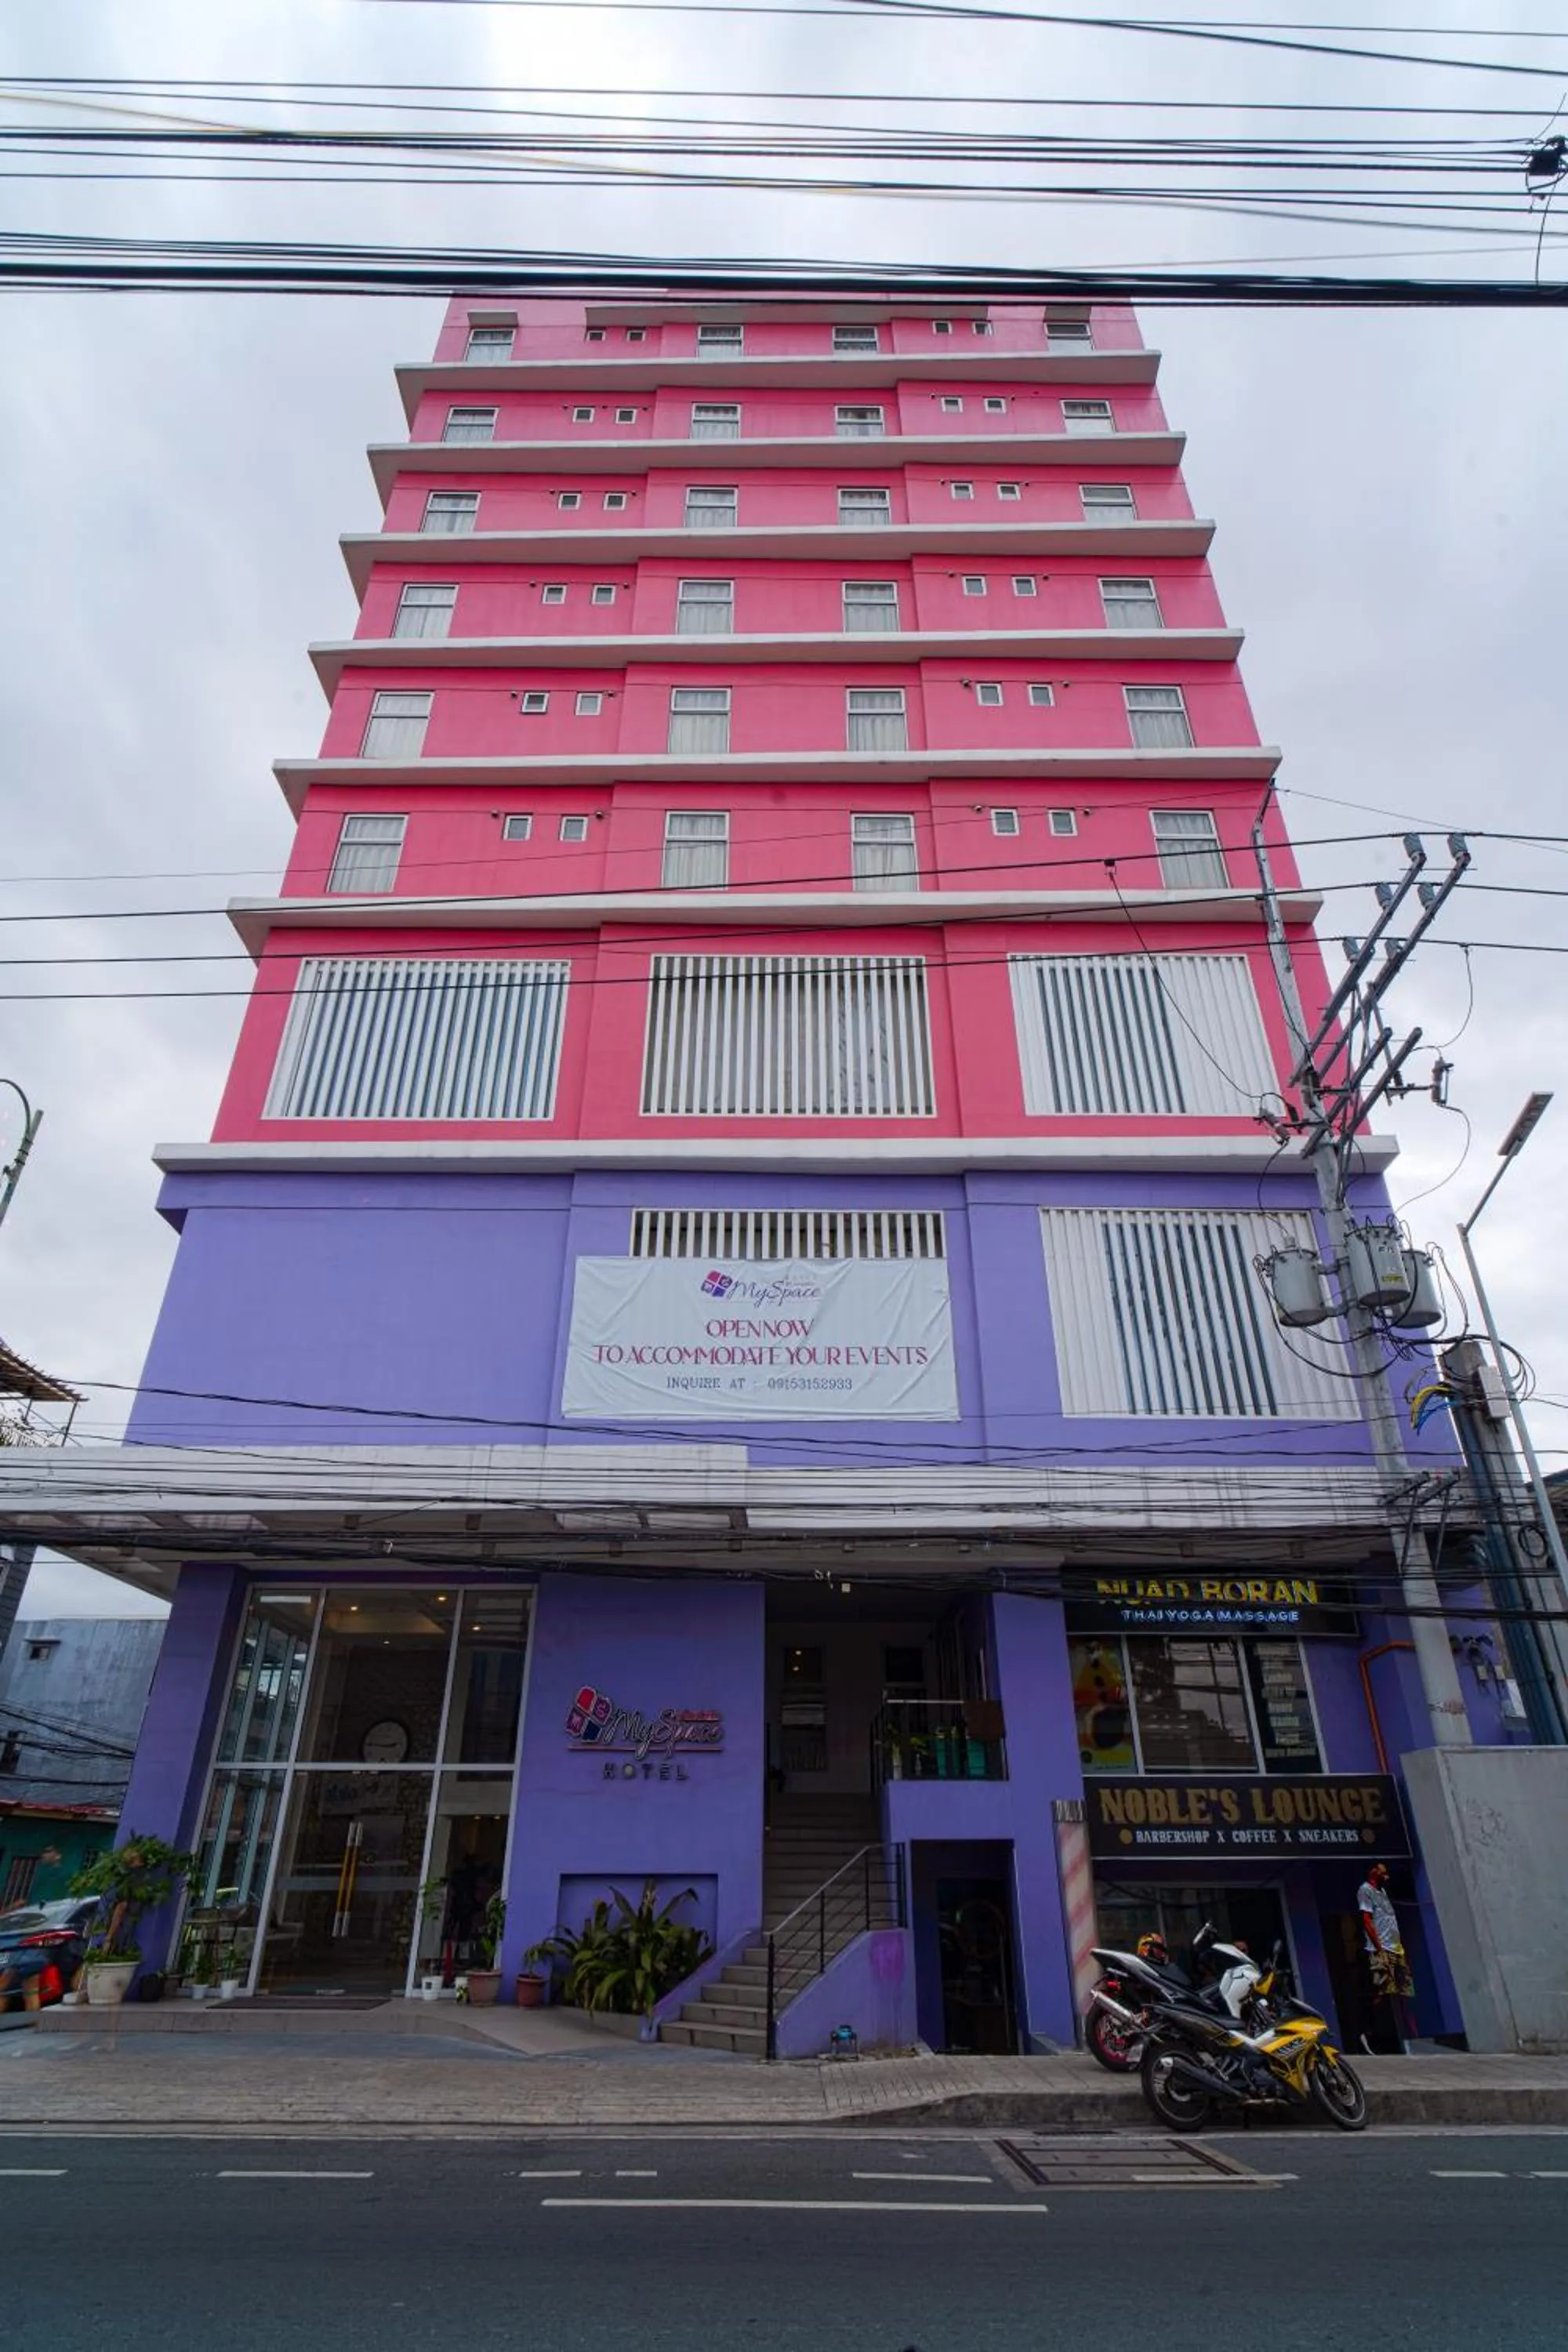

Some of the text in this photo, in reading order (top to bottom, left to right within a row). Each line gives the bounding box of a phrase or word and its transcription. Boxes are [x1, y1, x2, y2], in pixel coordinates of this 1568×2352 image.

[593, 1344, 928, 1366] TO ACCOMMODATE YOUR EVENTS
[666, 1376, 720, 1389] INQUIRE
[729, 1377, 746, 1389] AT
[1200, 1580, 1319, 1606] BORAN
[1217, 1610, 1300, 1623] MASSAGE
[604, 1763, 690, 1780] HOTEL
[1098, 1788, 1388, 1824] NOBLE'S LOUNGE
[1135, 1830, 1210, 1843] BARBERSHOP
[1232, 1830, 1277, 1843] COFFEE
[1298, 1828, 1359, 1842] SNEAKERS
